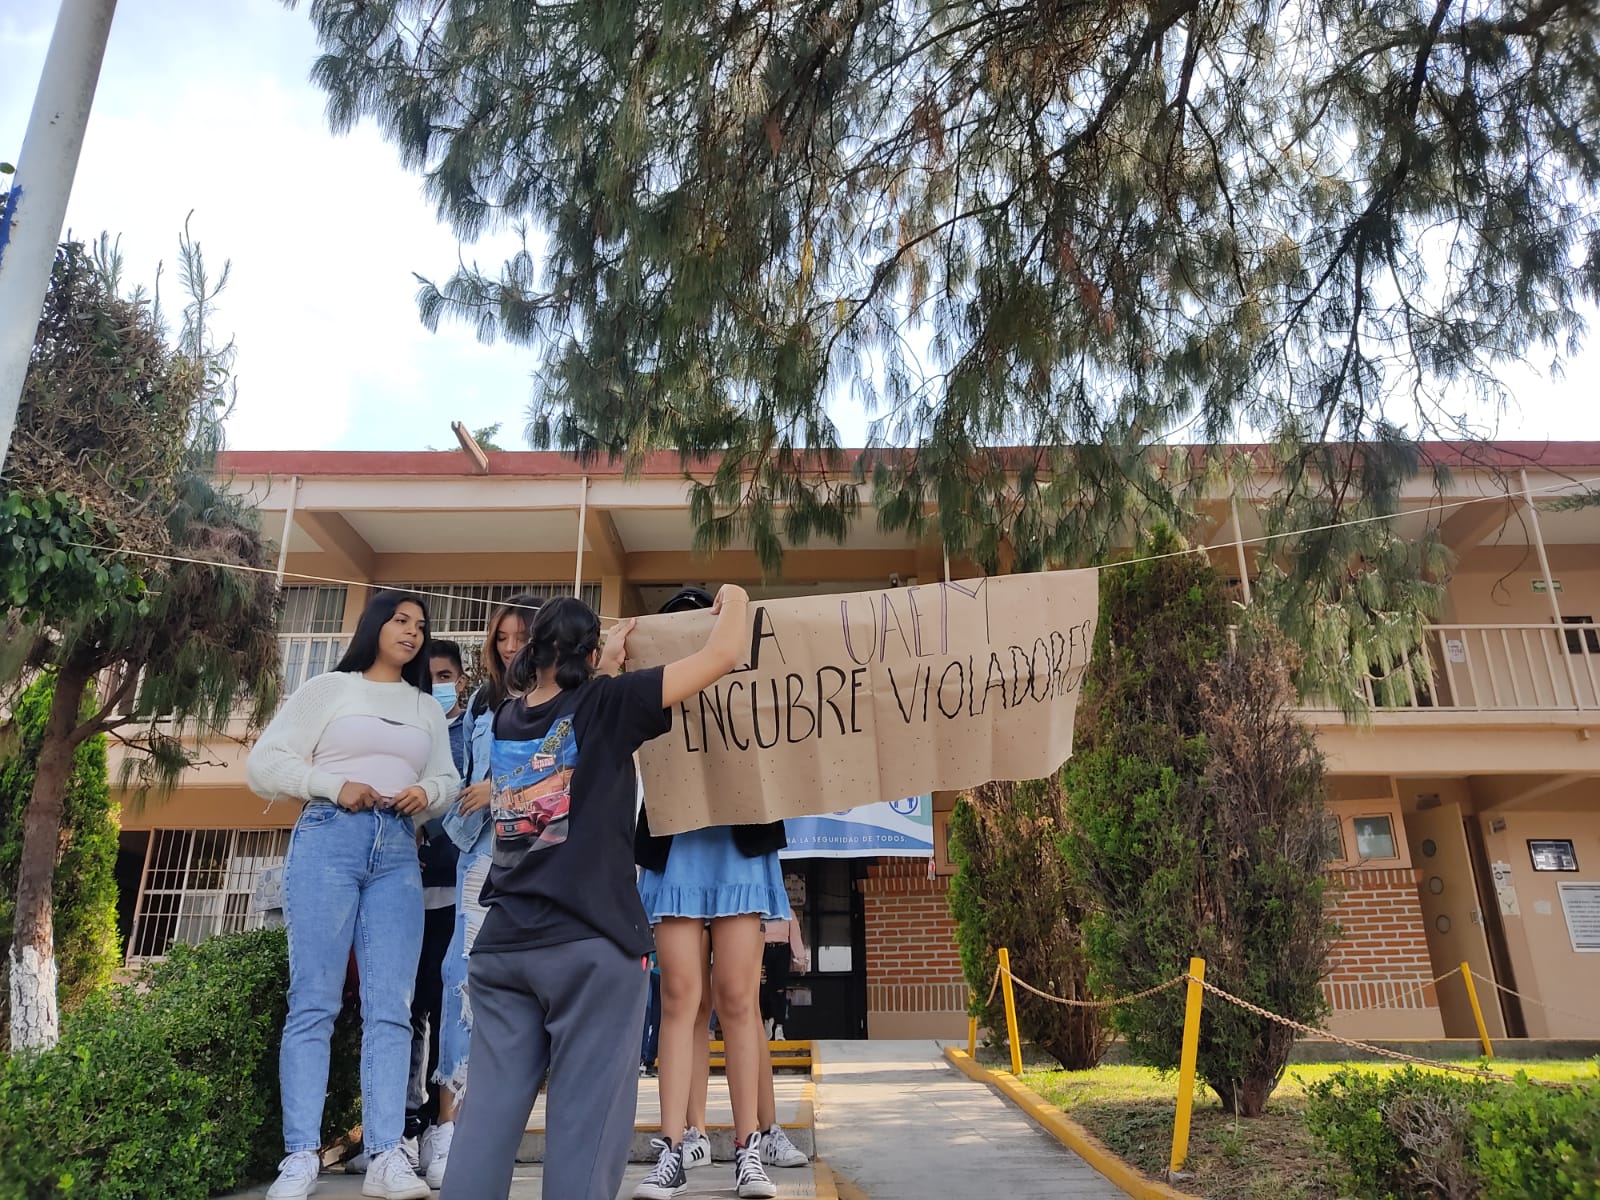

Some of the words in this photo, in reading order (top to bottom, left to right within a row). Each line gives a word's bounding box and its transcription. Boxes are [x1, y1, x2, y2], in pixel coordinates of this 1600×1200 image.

[840, 577, 990, 666] UAEM
[680, 665, 867, 753] ENCUBRE
[888, 619, 1091, 724] VIOLADORES
[800, 836, 809, 844] LA
[813, 835, 860, 844] SEGURIDAD
[862, 835, 873, 843] DE
